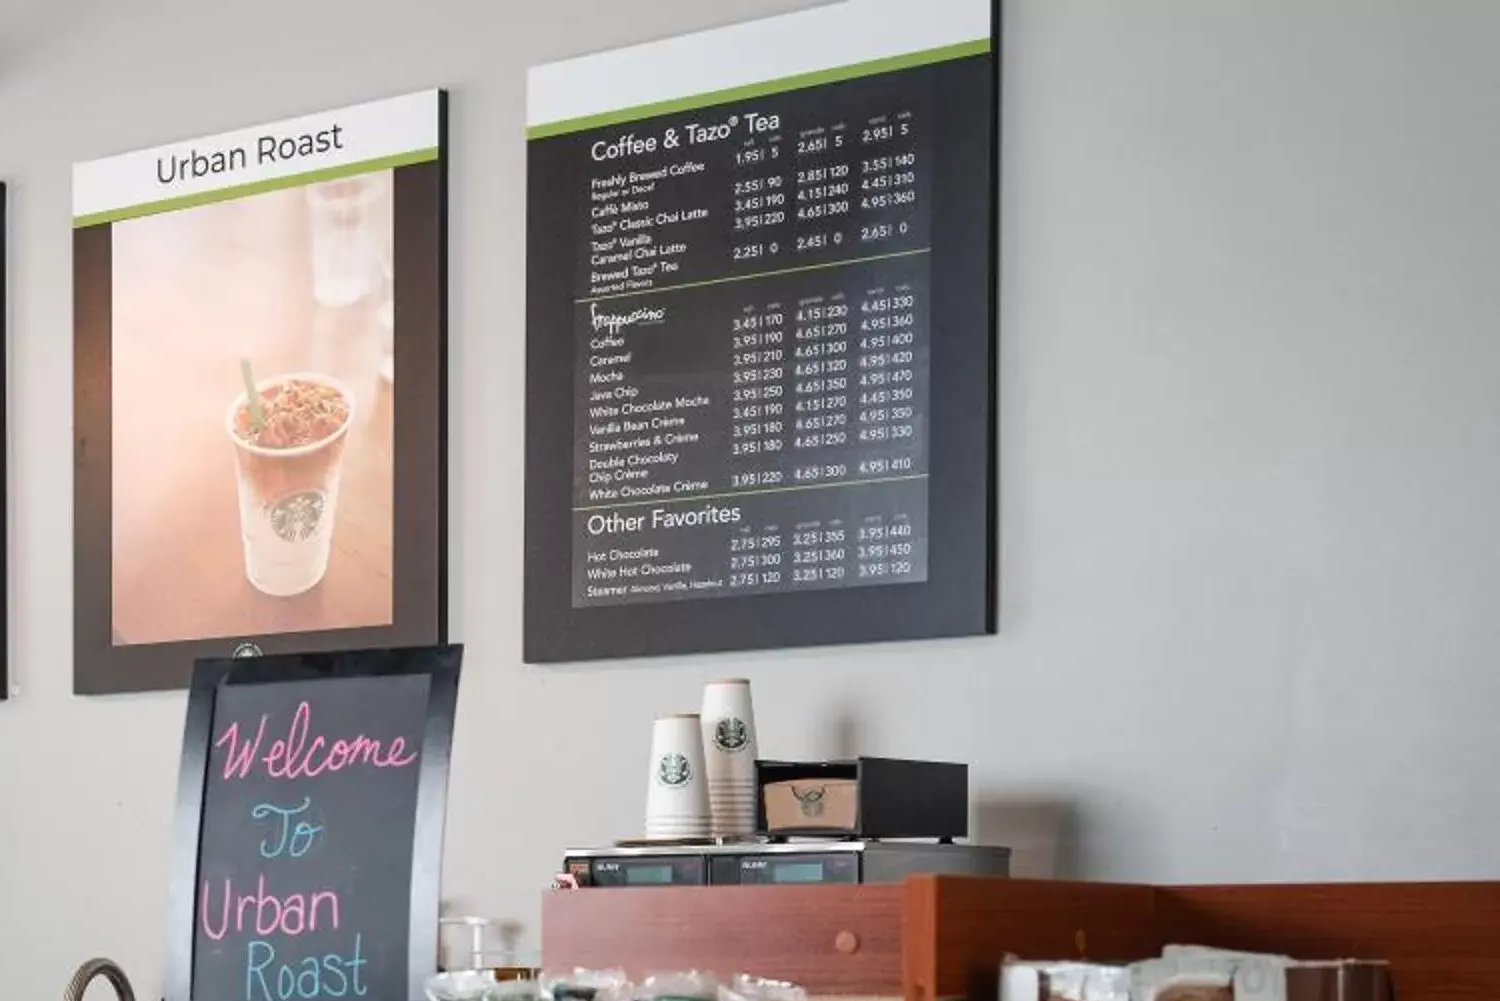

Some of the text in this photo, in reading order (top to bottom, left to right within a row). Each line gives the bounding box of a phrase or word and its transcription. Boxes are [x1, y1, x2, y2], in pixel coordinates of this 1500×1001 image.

[157, 124, 344, 184] Urban Roast
[591, 133, 657, 161] Coffee
[663, 128, 680, 148] &
[744, 113, 780, 134] Tea
[669, 161, 705, 176] Coffee
[660, 260, 679, 272] Tea
[587, 504, 741, 535] Other Favorites
[216, 701, 418, 779] Welcome
[252, 796, 322, 858] To
[201, 874, 339, 940] Urban
